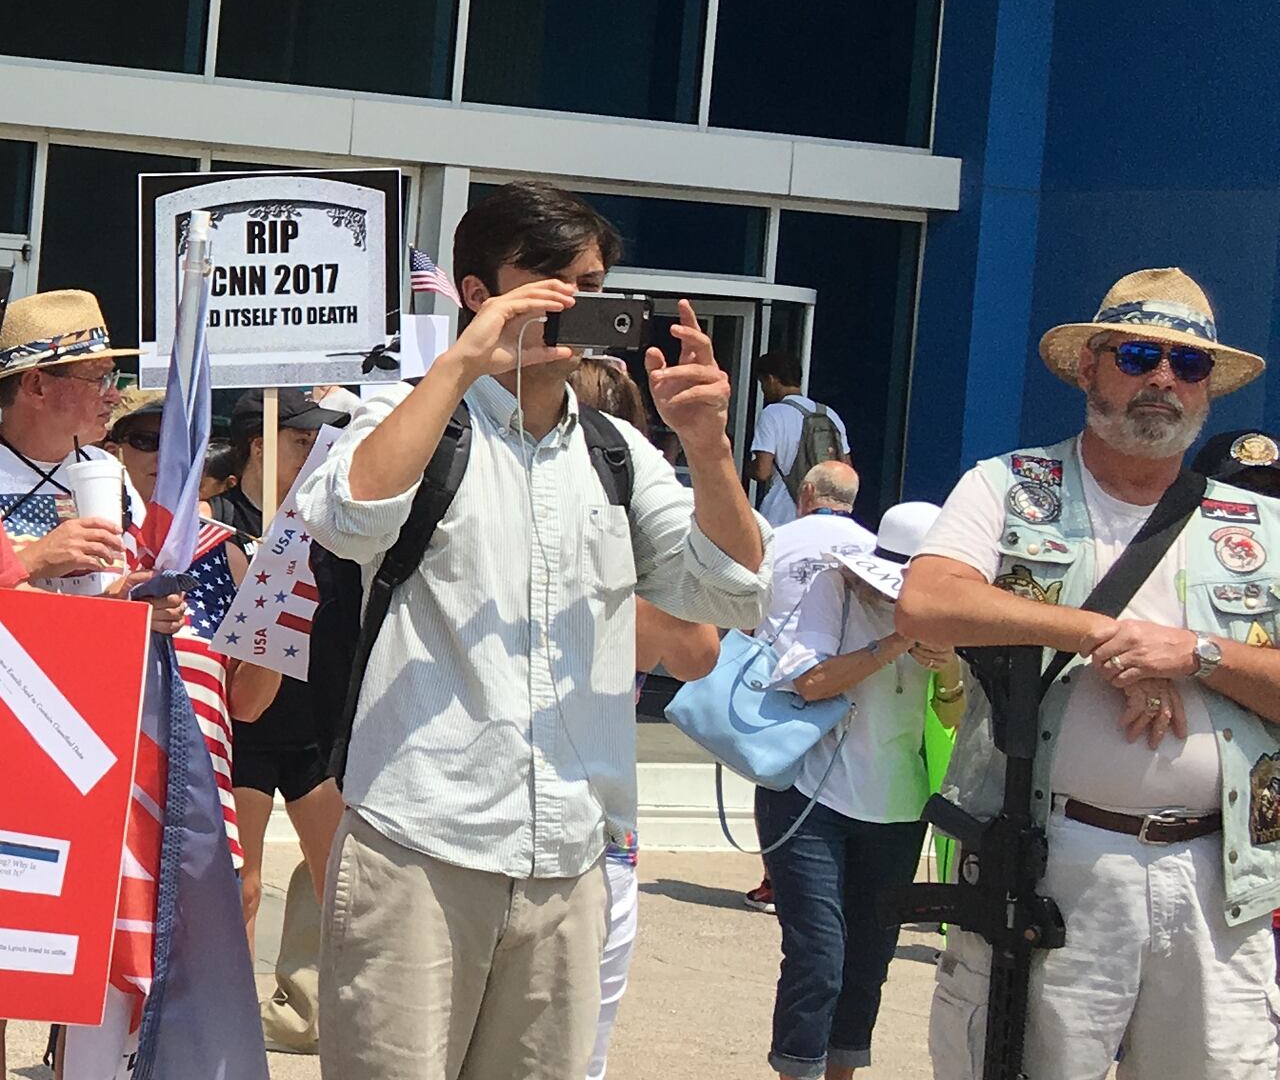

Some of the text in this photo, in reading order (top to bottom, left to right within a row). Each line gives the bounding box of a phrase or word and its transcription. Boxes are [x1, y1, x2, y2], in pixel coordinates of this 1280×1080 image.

[246, 220, 299, 254] RIP
[211, 264, 339, 297] CNN 2017
[225, 307, 277, 327] ITSELF
[281, 307, 302, 326] TO
[307, 306, 357, 325] DEATH
[271, 529, 296, 555] USA
[286, 560, 297, 575] USA
[253, 628, 267, 655] USA
